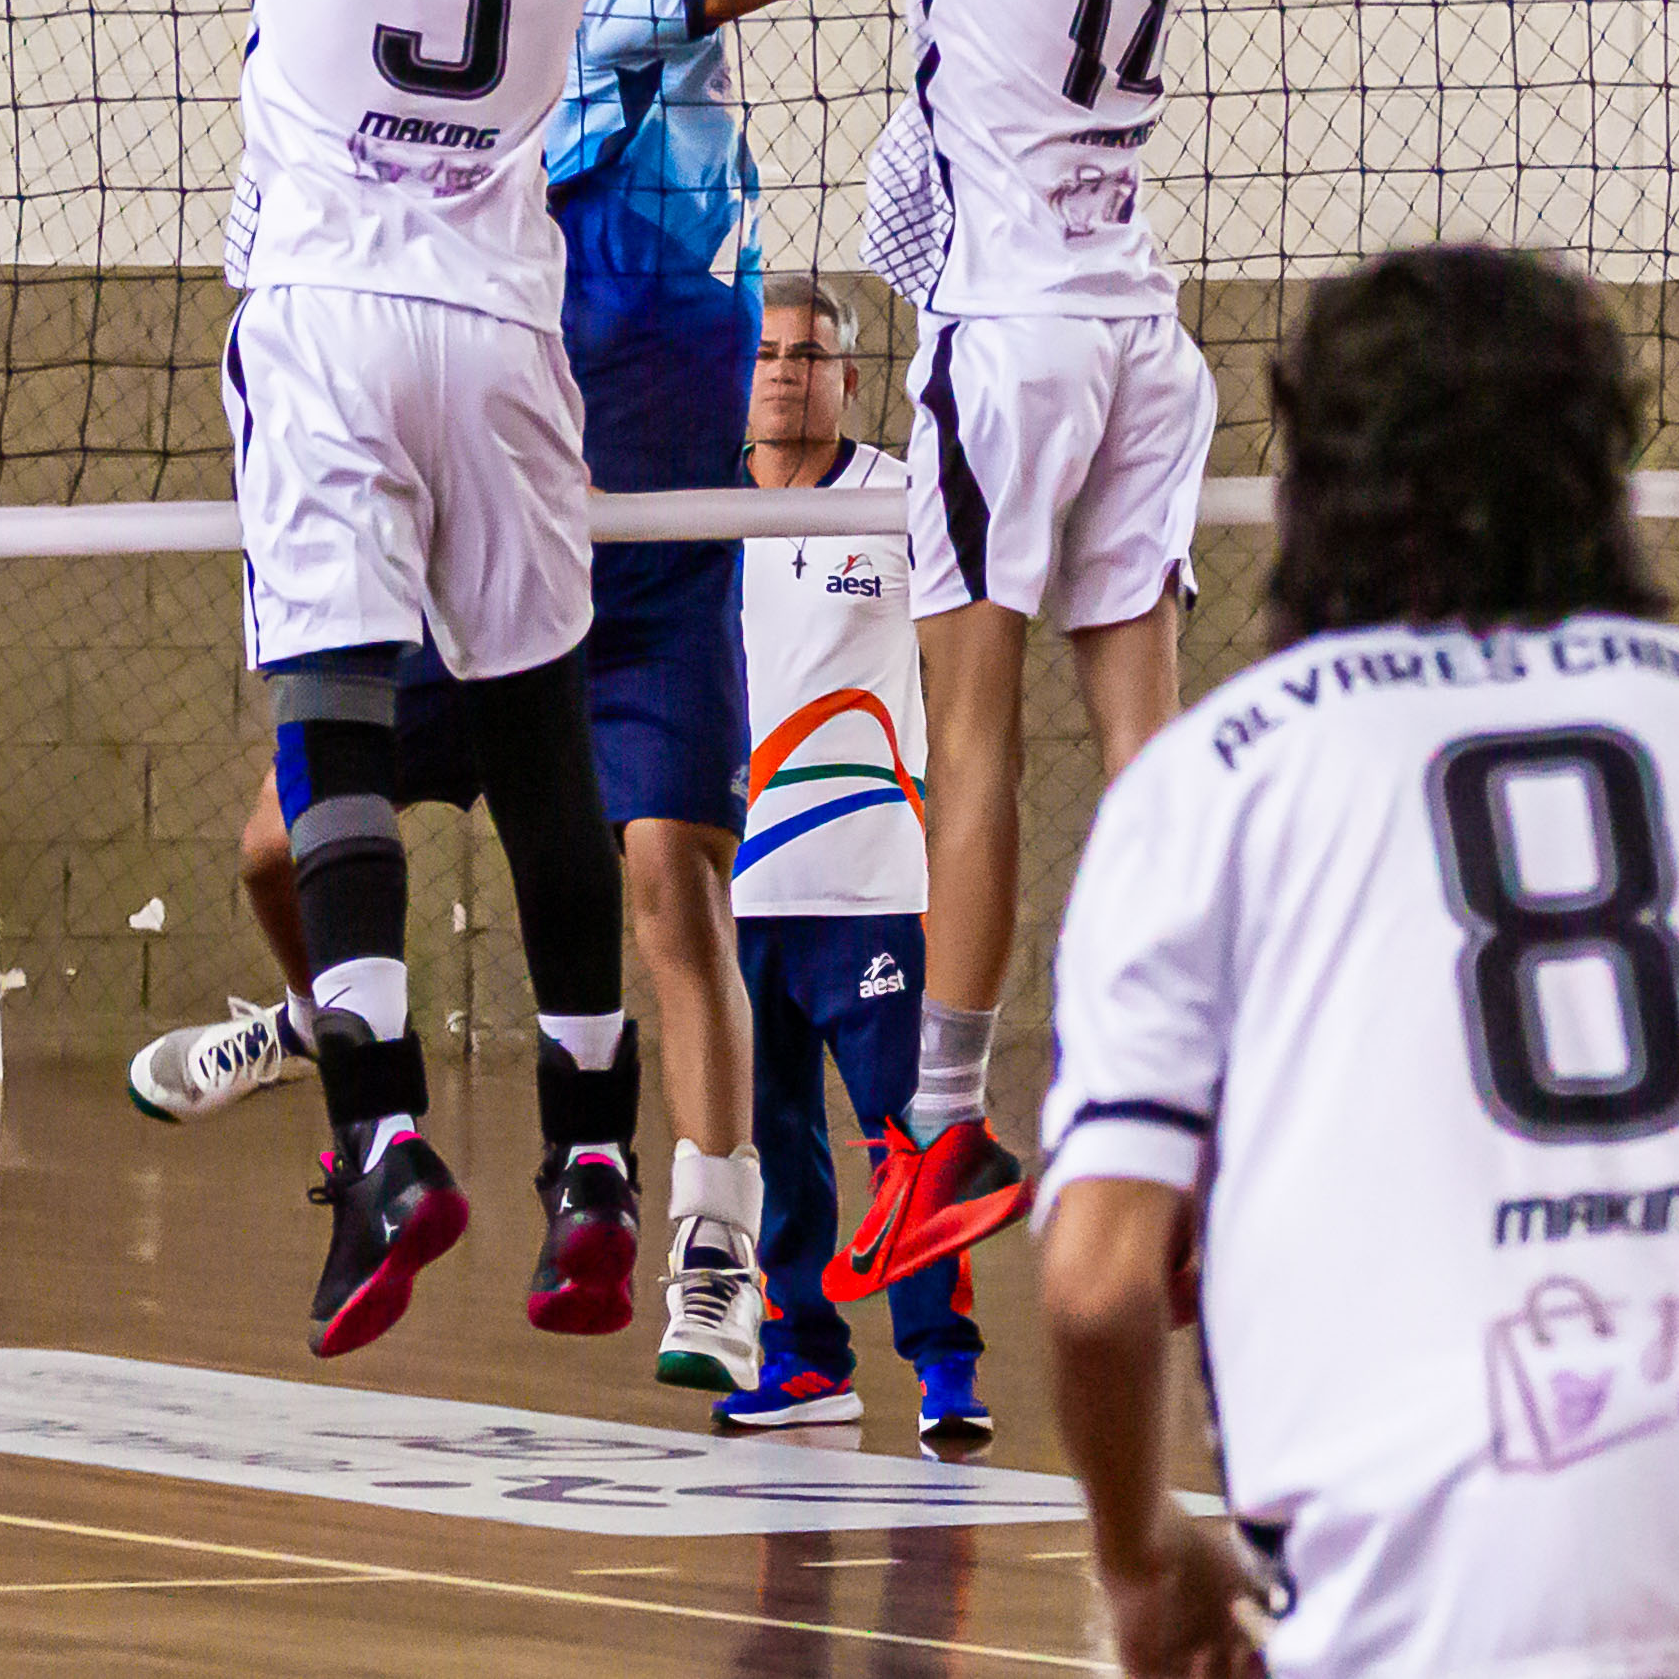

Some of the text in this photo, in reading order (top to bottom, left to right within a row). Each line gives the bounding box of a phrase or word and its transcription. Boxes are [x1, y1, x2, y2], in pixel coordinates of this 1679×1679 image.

[358, 110, 500, 150] MAKING
[826, 573, 883, 598] aest
[859, 967, 906, 1000] aest
